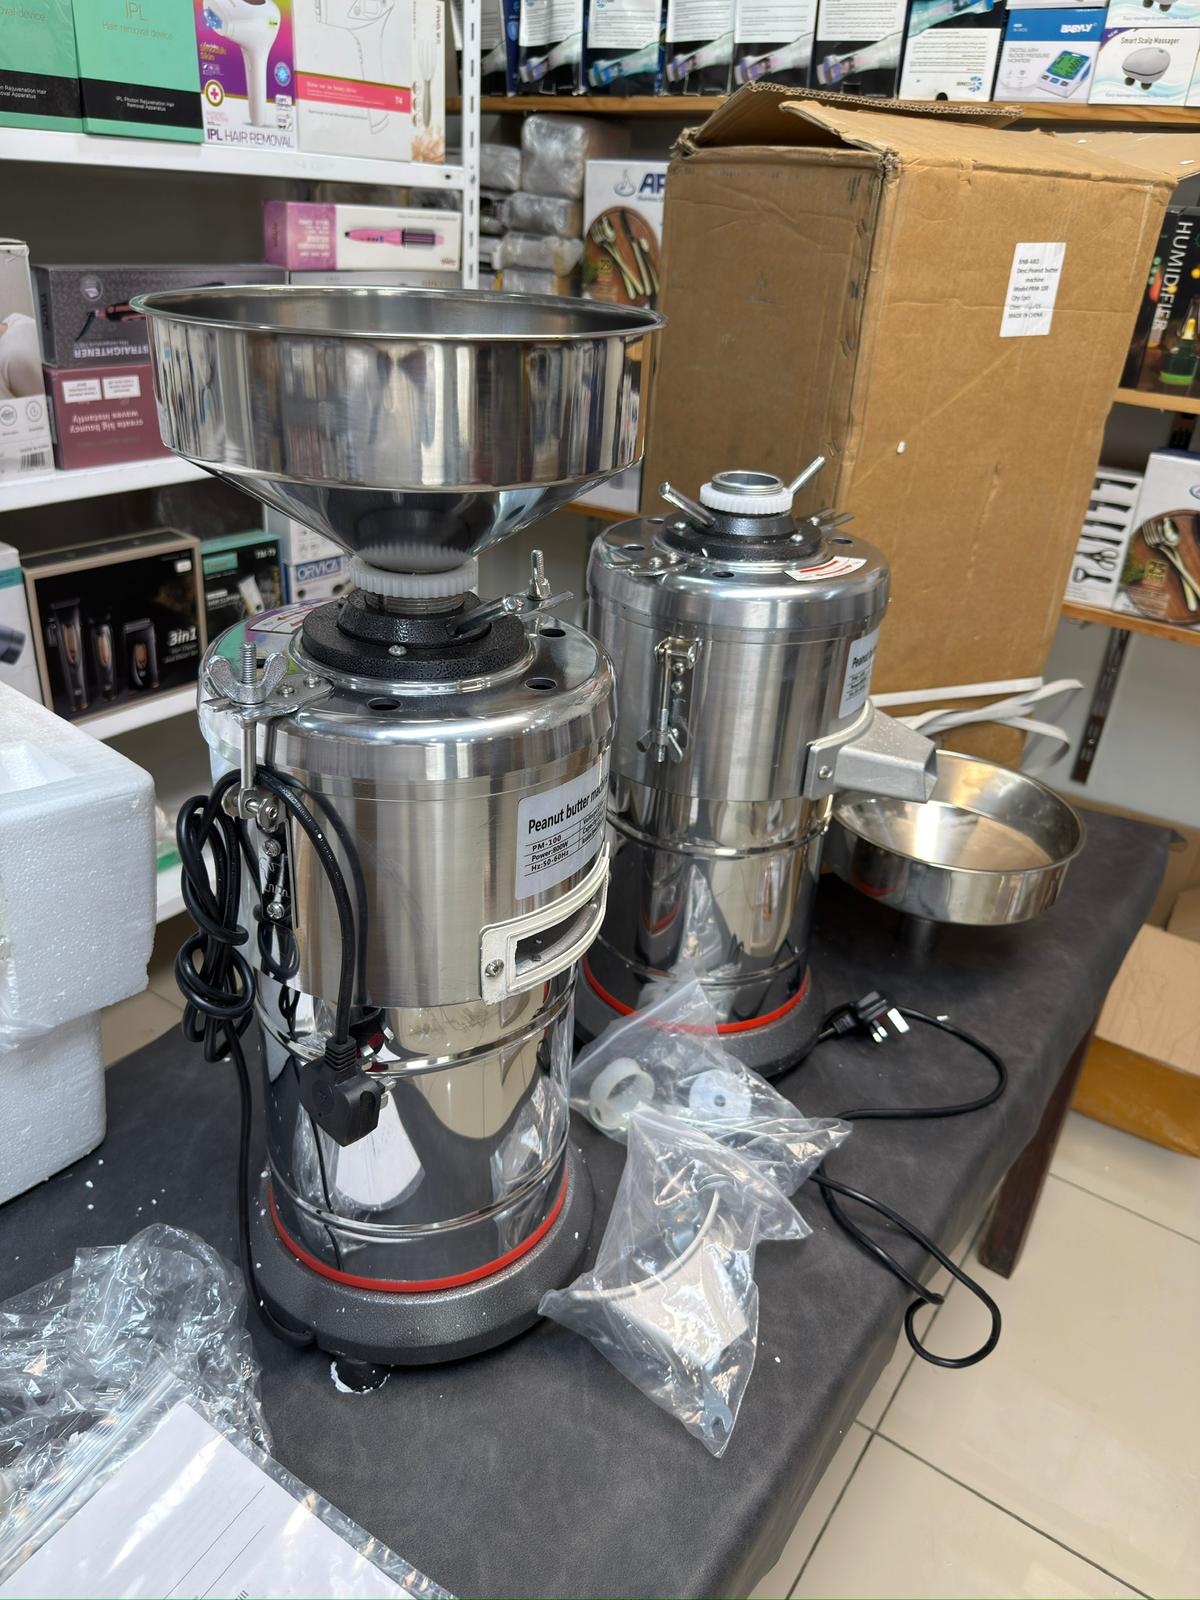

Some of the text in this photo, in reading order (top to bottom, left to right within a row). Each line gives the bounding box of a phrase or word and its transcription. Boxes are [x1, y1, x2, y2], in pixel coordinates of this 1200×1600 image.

[1121, 37, 1137, 45] Smart
[207, 127, 295, 149] IPL HAIR REMOVAL
[1151, 221, 1194, 331] HUMIDIFIER
[74, 344, 149, 358] STRAIGHTENER
[72, 412, 111, 424] instantly
[116, 419, 144, 429] create
[168, 625, 198, 647] 3in1
[528, 808, 564, 834] Peanut
[566, 794, 590, 820] butter
[532, 834, 562, 852] PM-100
[531, 850, 569, 872] Hz:50-60Hz
